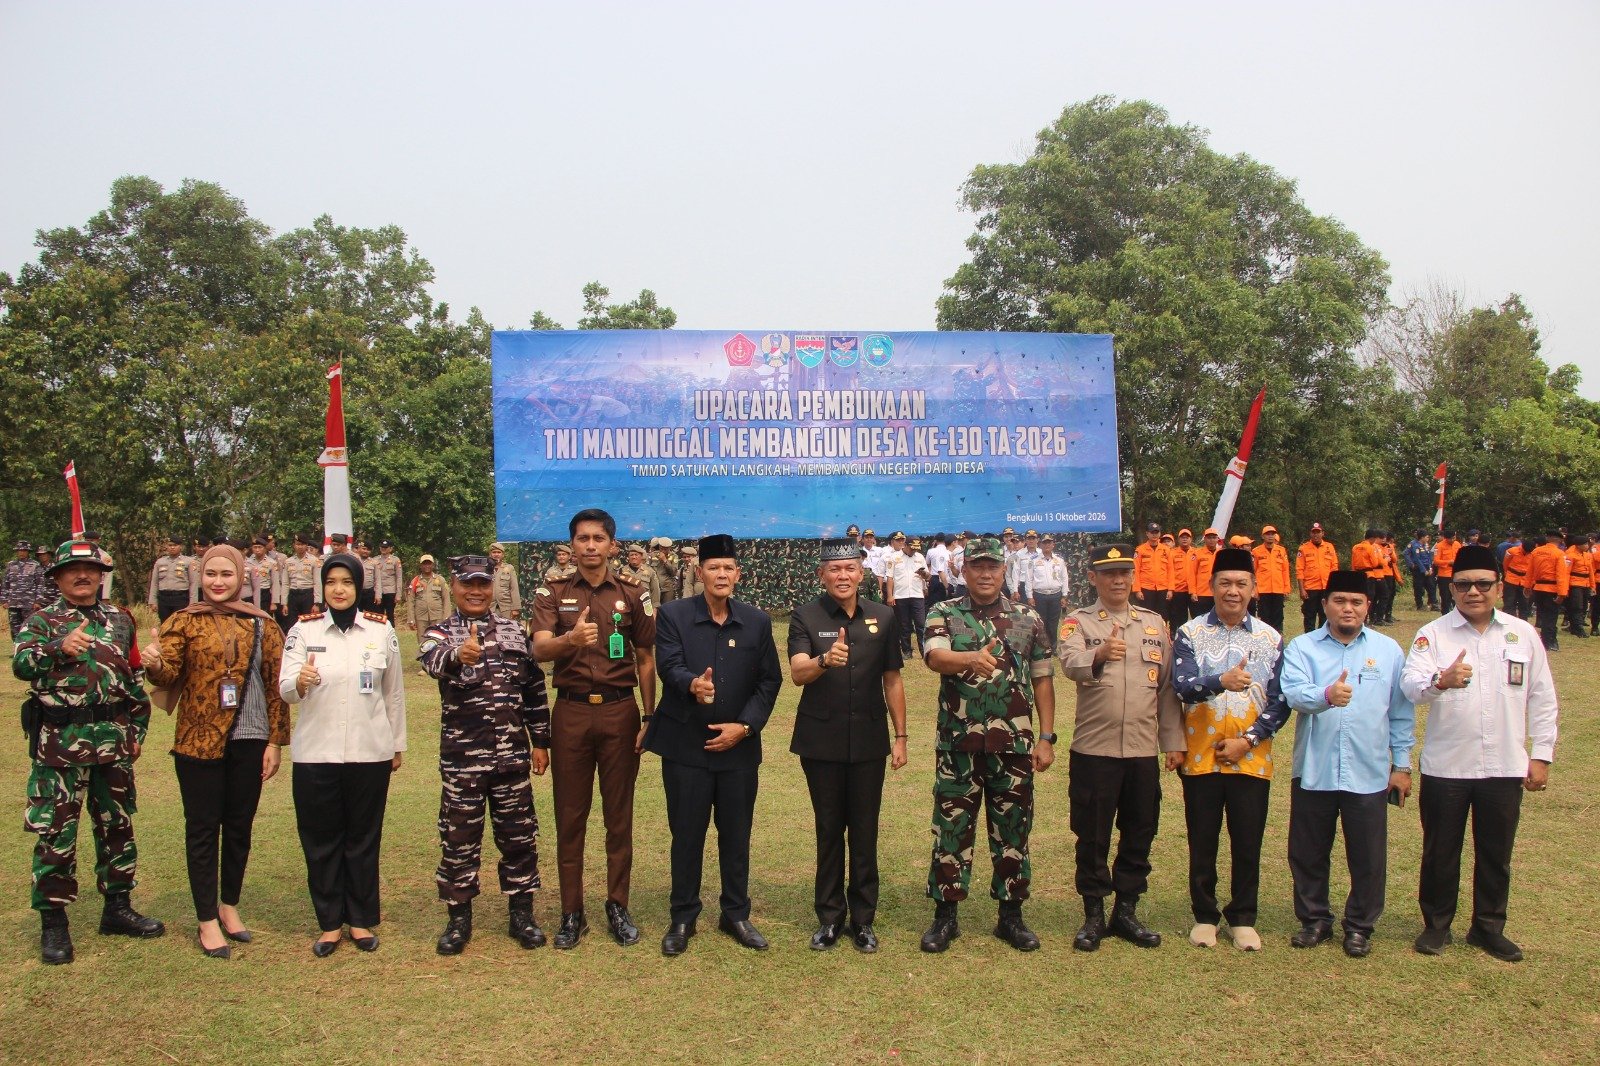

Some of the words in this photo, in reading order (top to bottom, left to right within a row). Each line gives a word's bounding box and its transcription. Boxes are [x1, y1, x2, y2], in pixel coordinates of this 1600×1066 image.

[694, 390, 793, 421] UPACARA
[797, 389, 926, 420] PEMBUKAAN
[543, 428, 578, 460] TNI
[582, 427, 714, 459] MANUNGGAL
[719, 427, 852, 459] MEMBANGUN
[856, 426, 910, 457] DESA
[914, 426, 983, 456] KE-130
[987, 426, 1012, 456] TA
[1015, 425, 1067, 456] 2026
[670, 464, 728, 477] SATUKAN
[731, 464, 794, 478] LANGKAH,
[797, 463, 876, 476] MEMBANGUN
[879, 462, 921, 475] NEGERI
[924, 462, 952, 475] DARI
[1006, 513, 1043, 523] Bengkulu
[1045, 513, 1054, 521] 13
[1055, 512, 1086, 521] Oktober
[1088, 512, 1107, 521] 2026
